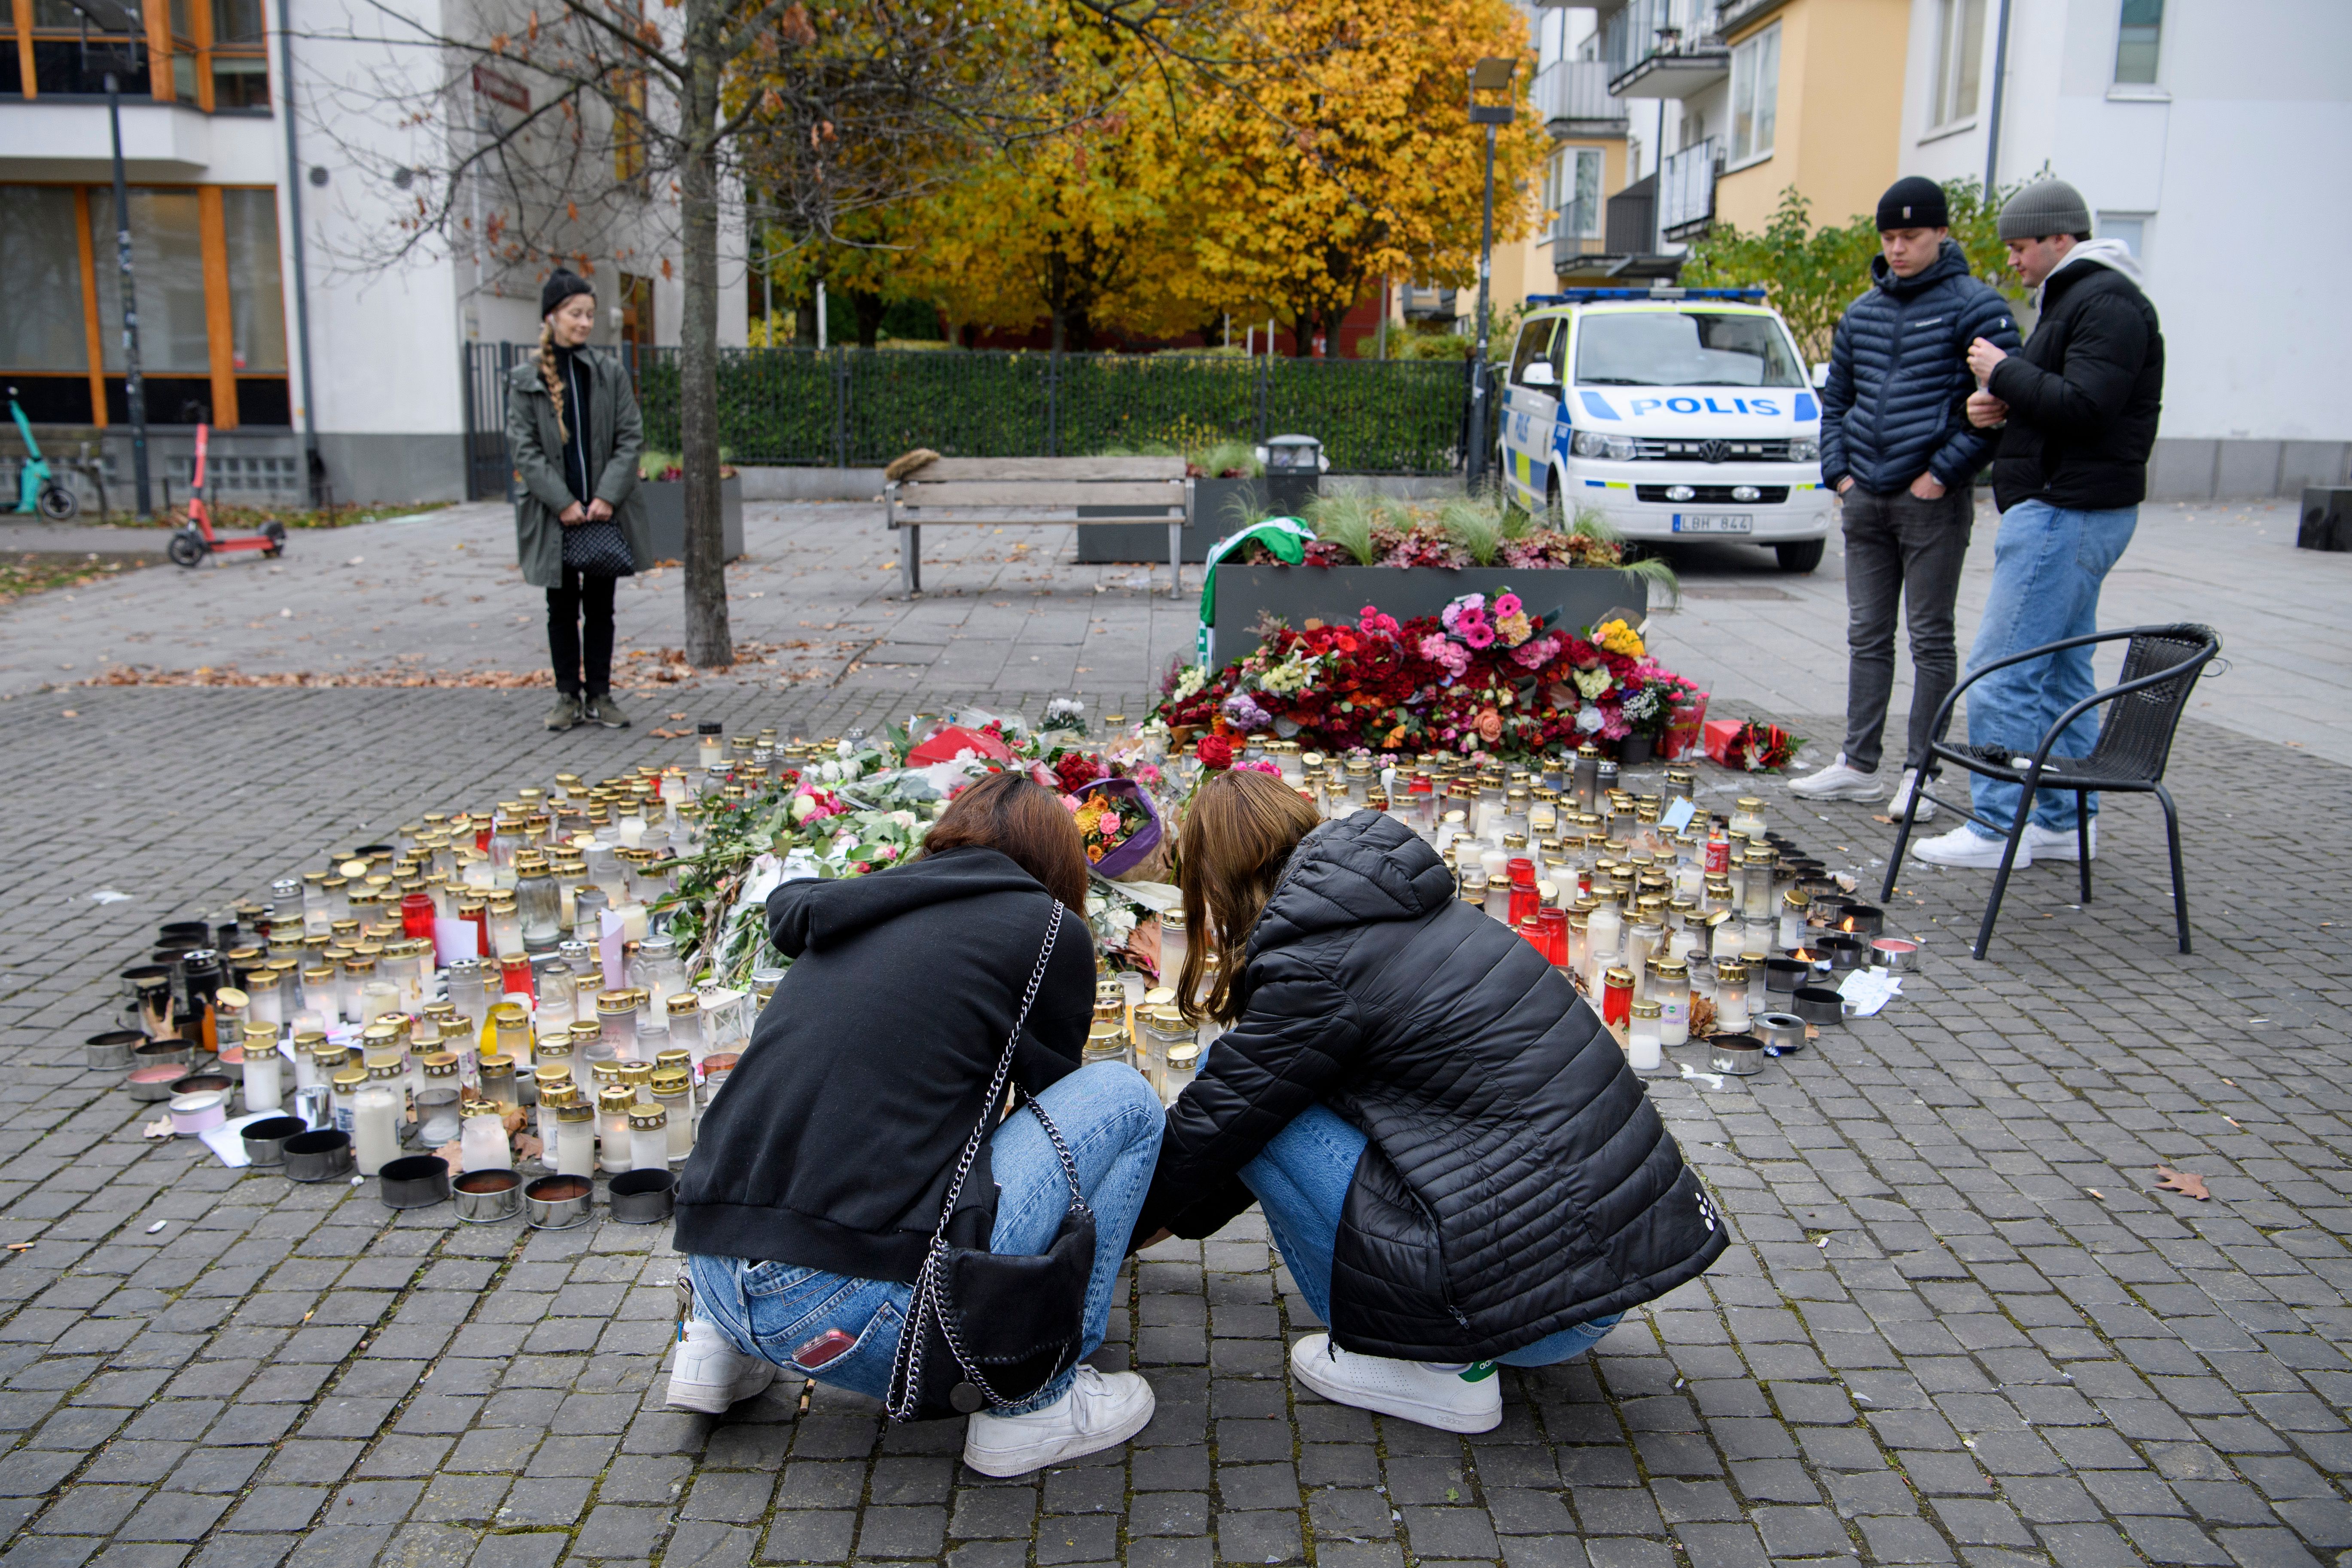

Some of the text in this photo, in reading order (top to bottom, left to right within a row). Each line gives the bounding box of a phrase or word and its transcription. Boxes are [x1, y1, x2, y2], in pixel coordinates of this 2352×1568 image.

[1630, 397, 1781, 416] POLIS
[1682, 516, 1747, 529] LBH 844
[1437, 1415, 1465, 1426] adidas
